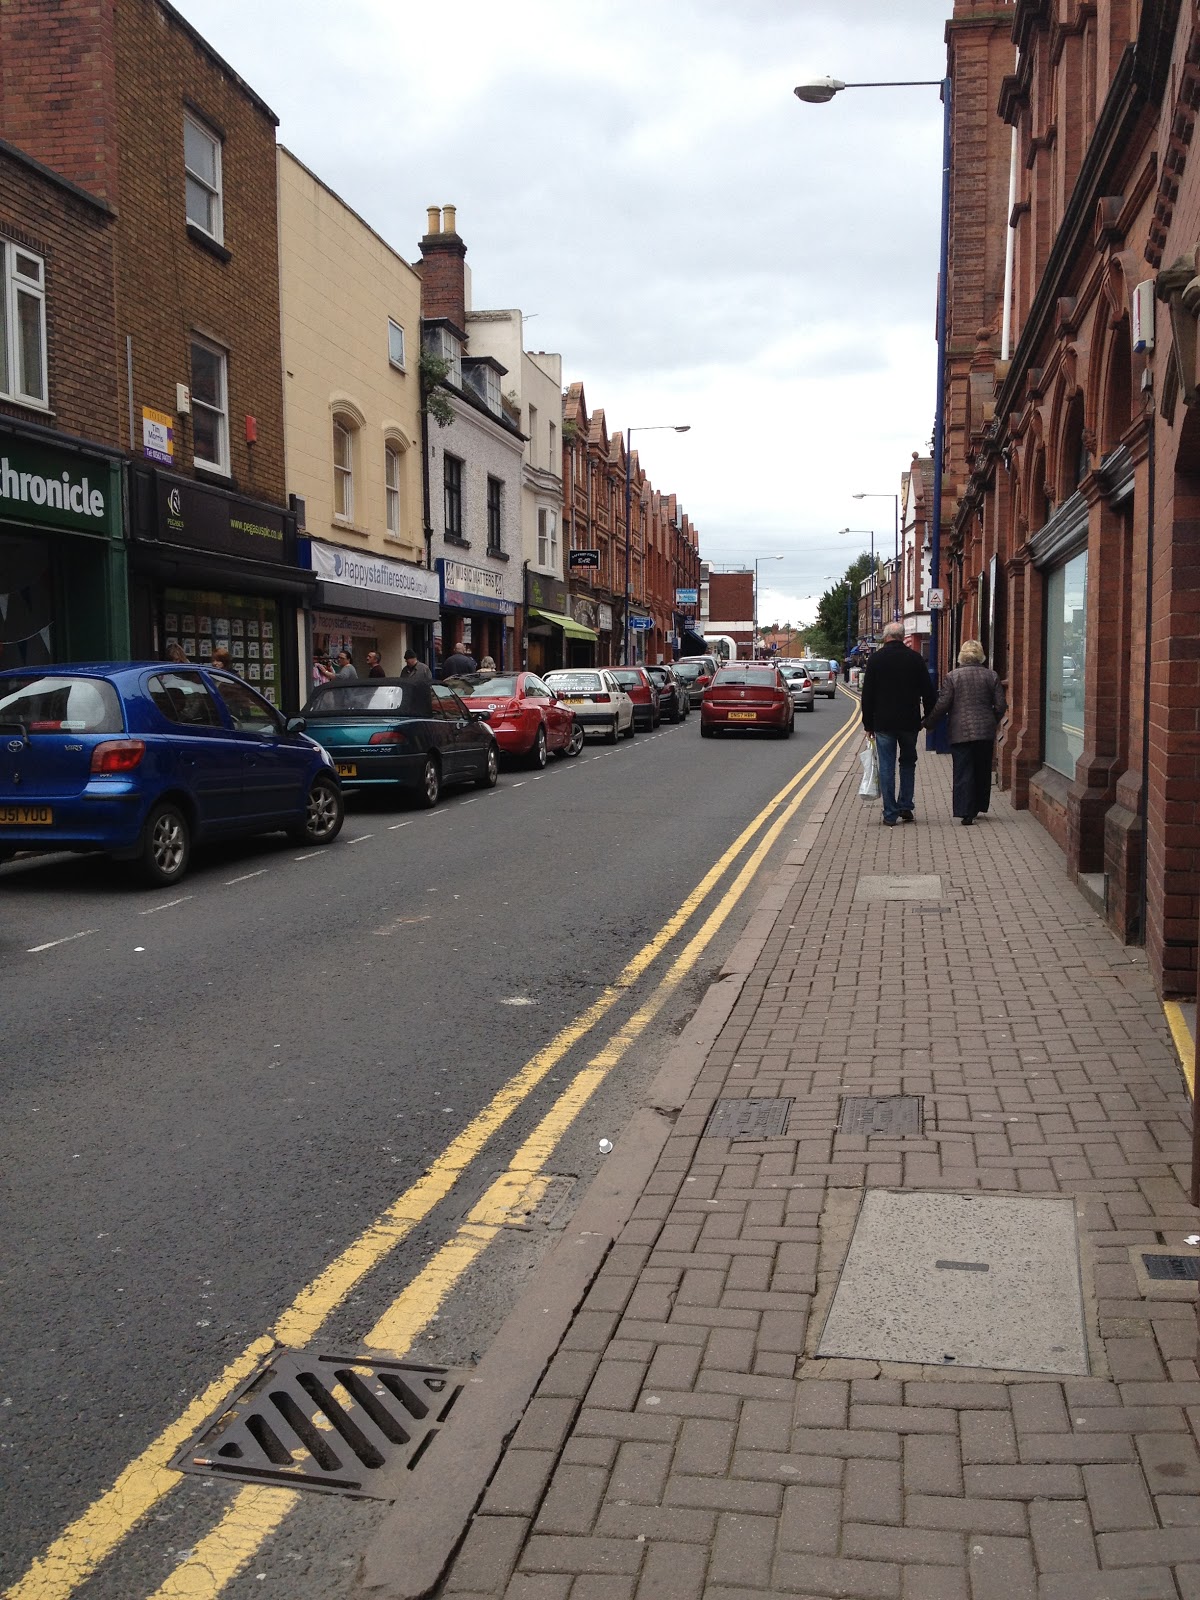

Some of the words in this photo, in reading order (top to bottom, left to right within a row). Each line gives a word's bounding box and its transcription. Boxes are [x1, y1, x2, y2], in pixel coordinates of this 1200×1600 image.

[148, 430, 164, 442] Morris
[152, 423, 160, 433] Tim
[0, 457, 105, 518] hronicle
[473, 568, 495, 588] MATTERS
